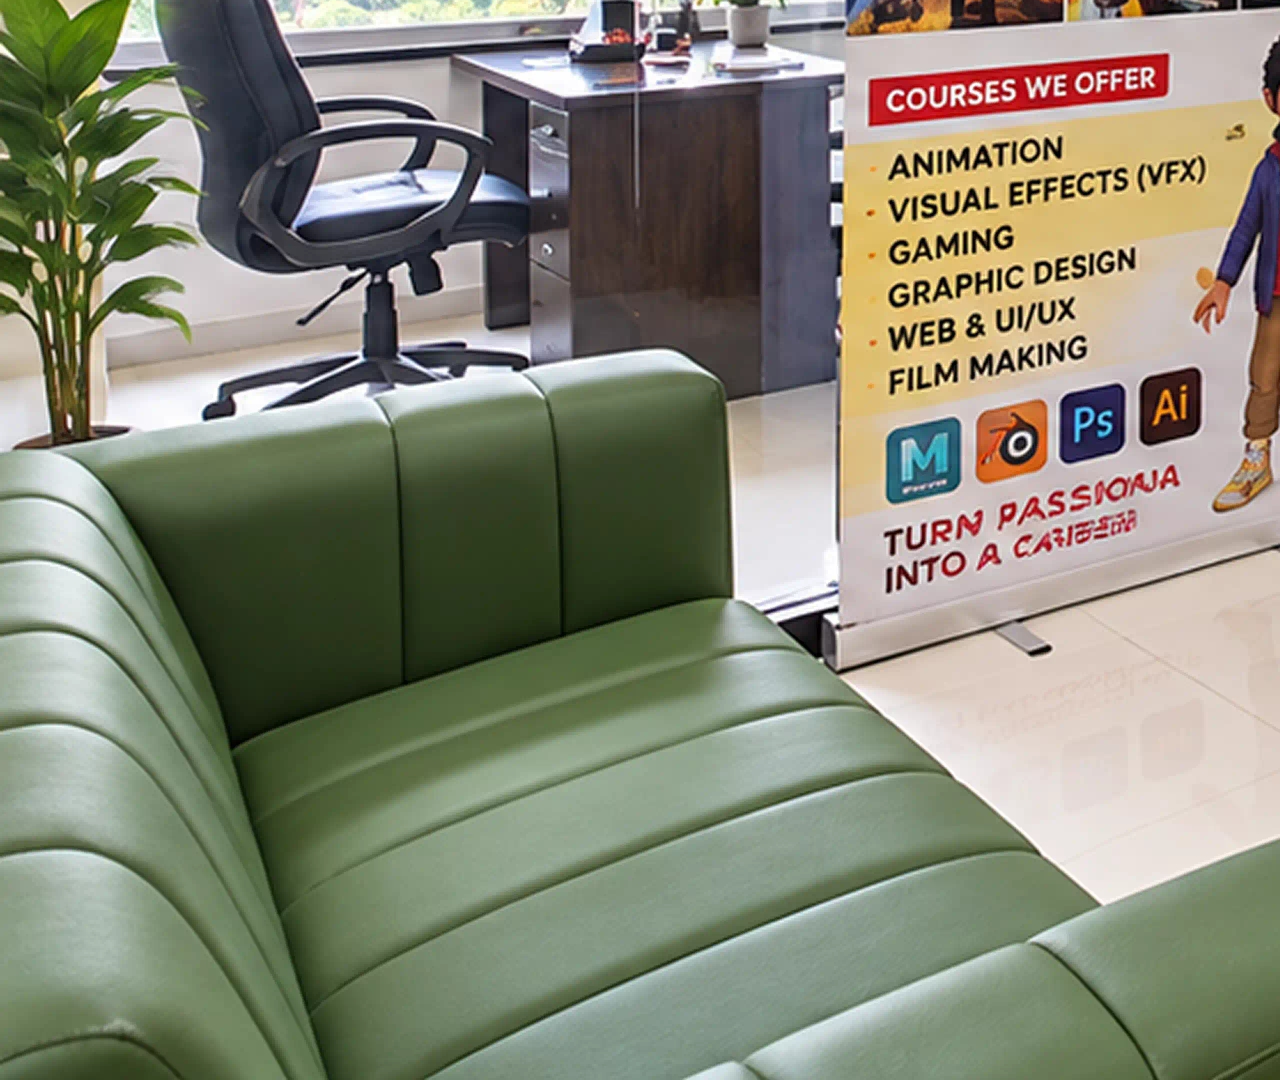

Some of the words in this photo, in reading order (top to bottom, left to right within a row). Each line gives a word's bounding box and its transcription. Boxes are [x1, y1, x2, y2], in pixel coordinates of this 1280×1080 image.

[886, 78, 1016, 113] COURSES
[1024, 74, 1068, 98] WE
[1074, 67, 1156, 95] OFFER
[887, 136, 1064, 180] ANIMATION
[888, 186, 999, 223] VISUAL
[1008, 167, 1129, 206] EFFECTS
[1138, 155, 1207, 190] (VFX)
[888, 225, 1015, 265] GAMING
[888, 268, 1025, 308] GRAPHIC
[1034, 247, 1137, 287] DESIGN
[888, 324, 956, 352] WEB
[965, 311, 986, 339] &
[994, 296, 1076, 334] UI/UX
[888, 360, 960, 395] FILM
[969, 335, 1088, 381] MAKING
[1074, 406, 1113, 443] Ps
[1152, 384, 1188, 426] Ai
[883, 510, 984, 556] TURN
[885, 551, 966, 594] INTO
